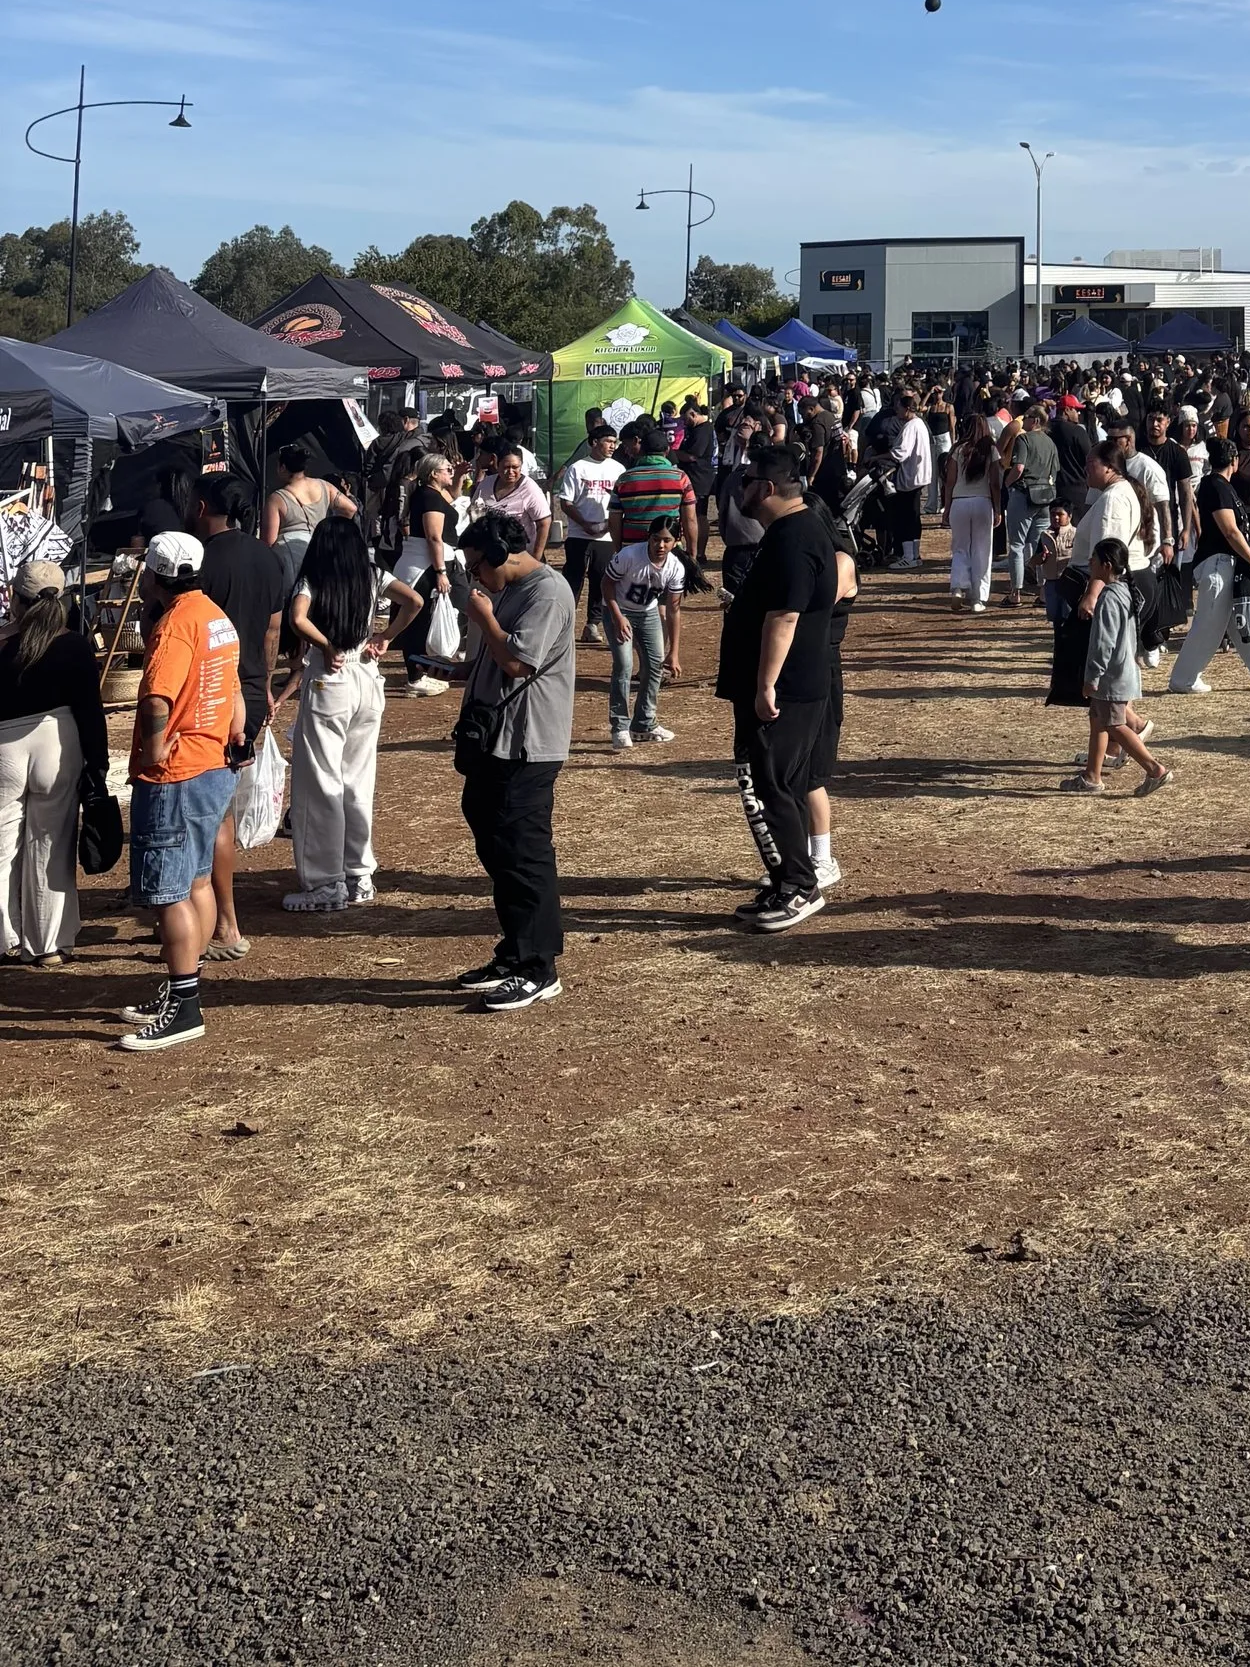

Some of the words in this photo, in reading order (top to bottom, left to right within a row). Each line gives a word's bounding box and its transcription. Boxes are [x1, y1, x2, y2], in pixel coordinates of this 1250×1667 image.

[594, 346, 629, 354] KITCHEN
[585, 363, 627, 376] KITCHEN
[629, 362, 661, 375] LUXOR
